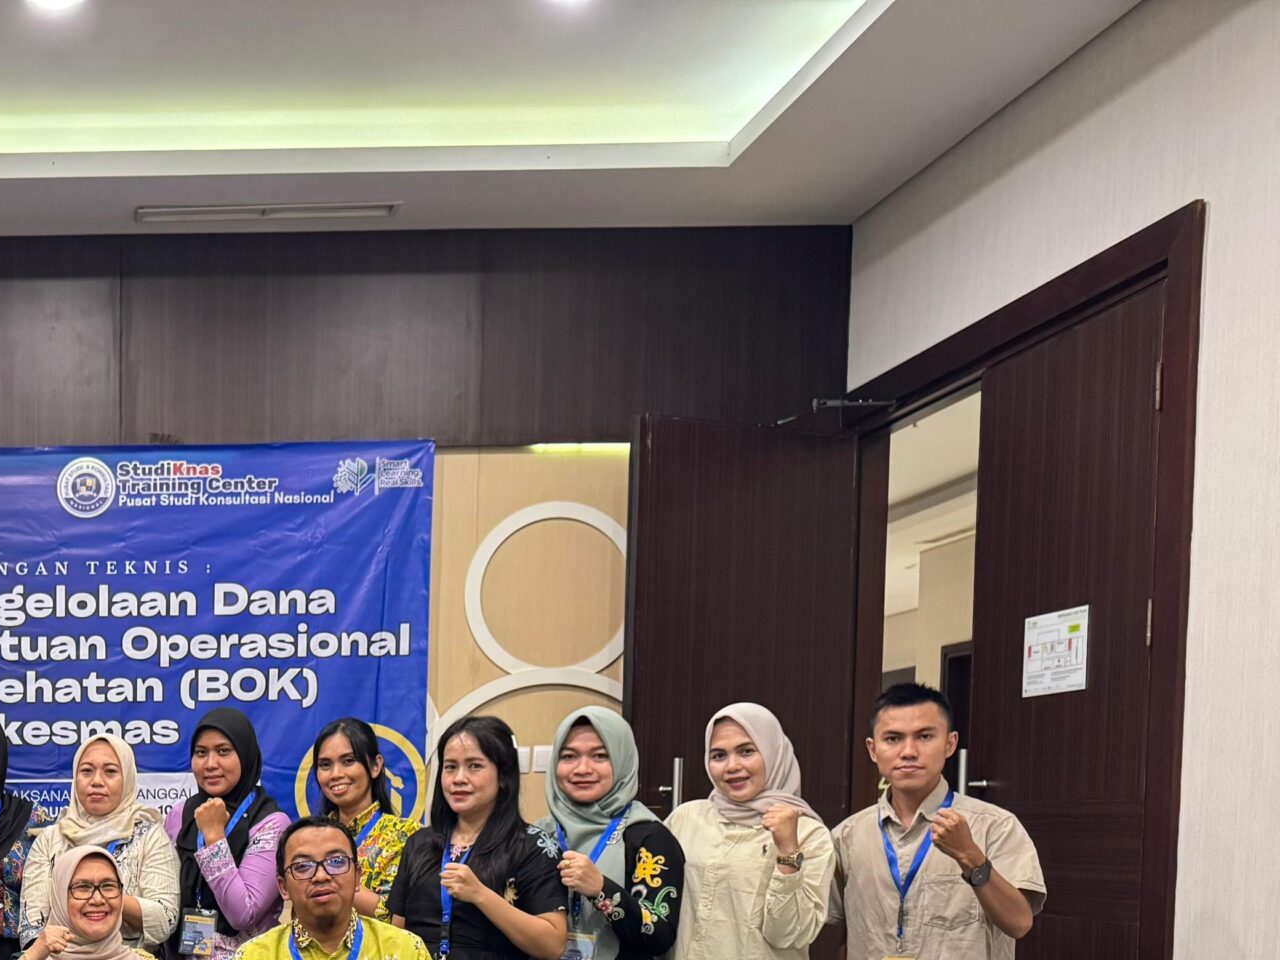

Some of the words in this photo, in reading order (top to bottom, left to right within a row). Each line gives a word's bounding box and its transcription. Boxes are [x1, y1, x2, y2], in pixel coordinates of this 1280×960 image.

[118, 462, 220, 477] StudiKnas
[381, 460, 408, 469] Smart
[118, 477, 202, 496] Training
[207, 475, 278, 492] Center
[380, 479, 399, 487] Real
[119, 495, 156, 506] Pusat
[160, 493, 196, 506] Studi
[200, 491, 271, 505] Konsultasi
[274, 489, 334, 504] Nasional
[86, 560, 189, 575] TEKNIS
[213, 582, 336, 617] Dana
[122, 622, 411, 668] Operasional
[180, 667, 319, 710] (BOK)
